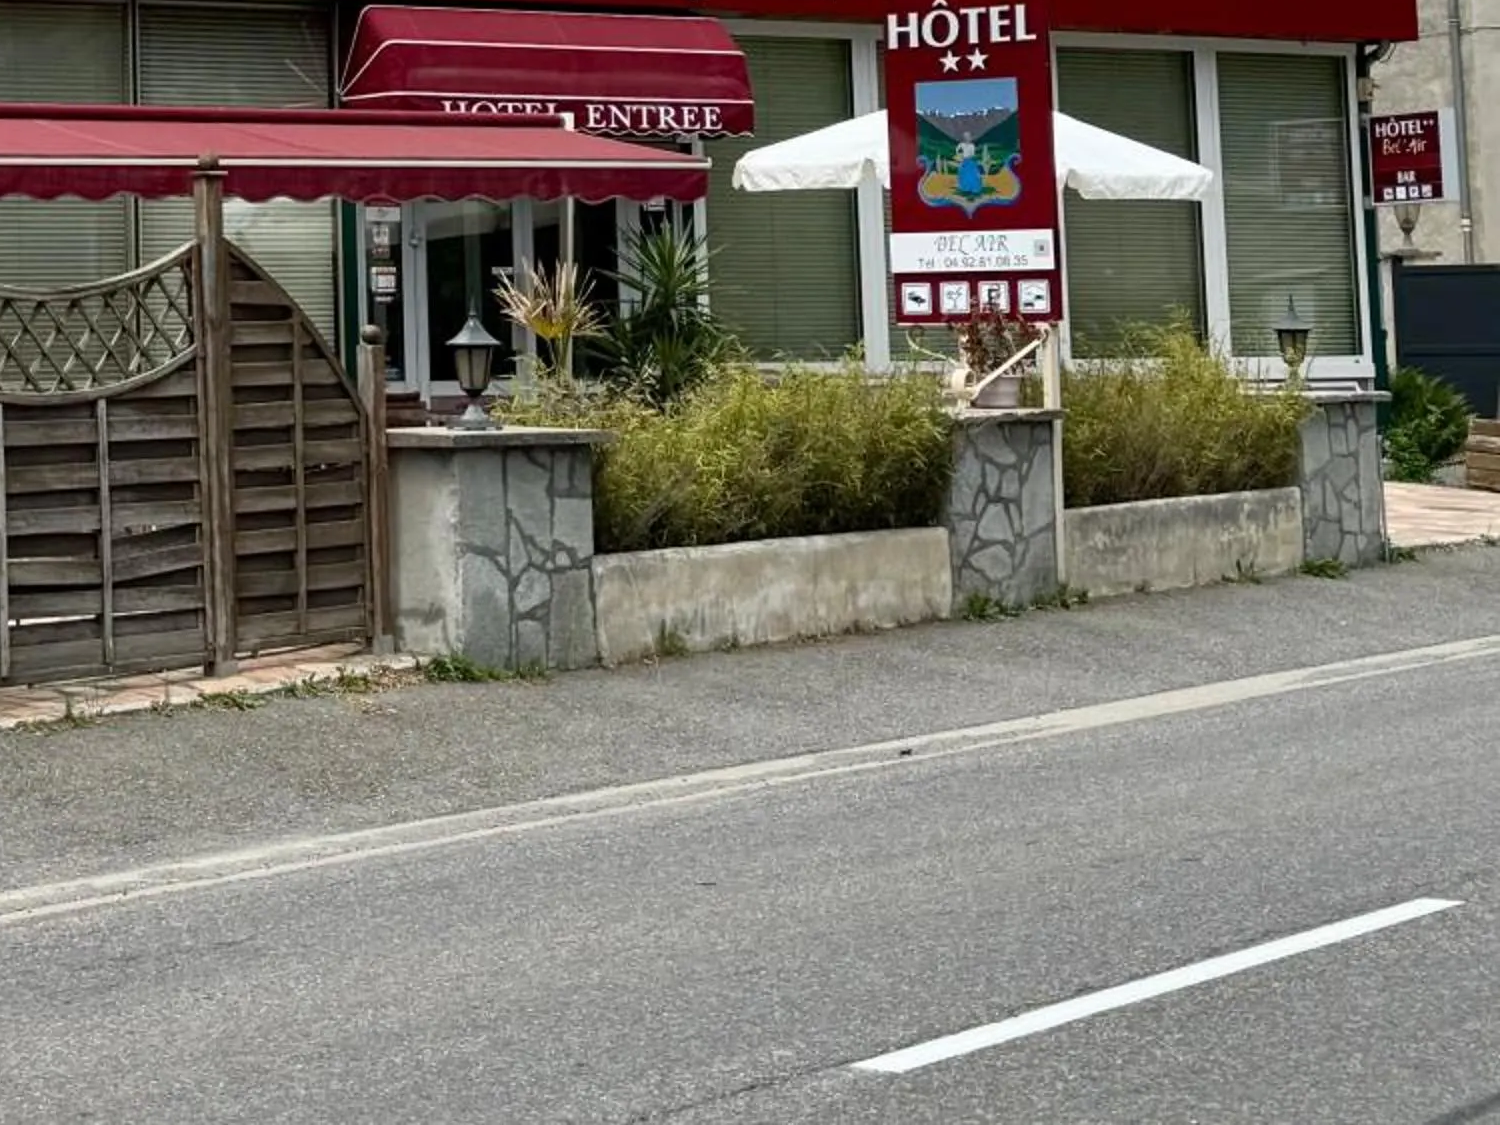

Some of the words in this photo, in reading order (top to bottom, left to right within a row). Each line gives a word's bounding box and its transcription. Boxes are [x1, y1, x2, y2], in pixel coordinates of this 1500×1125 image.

[585, 103, 724, 130] ENTREE
[1374, 116, 1425, 138] HÔTEL
[1396, 170, 1417, 184] BAR
